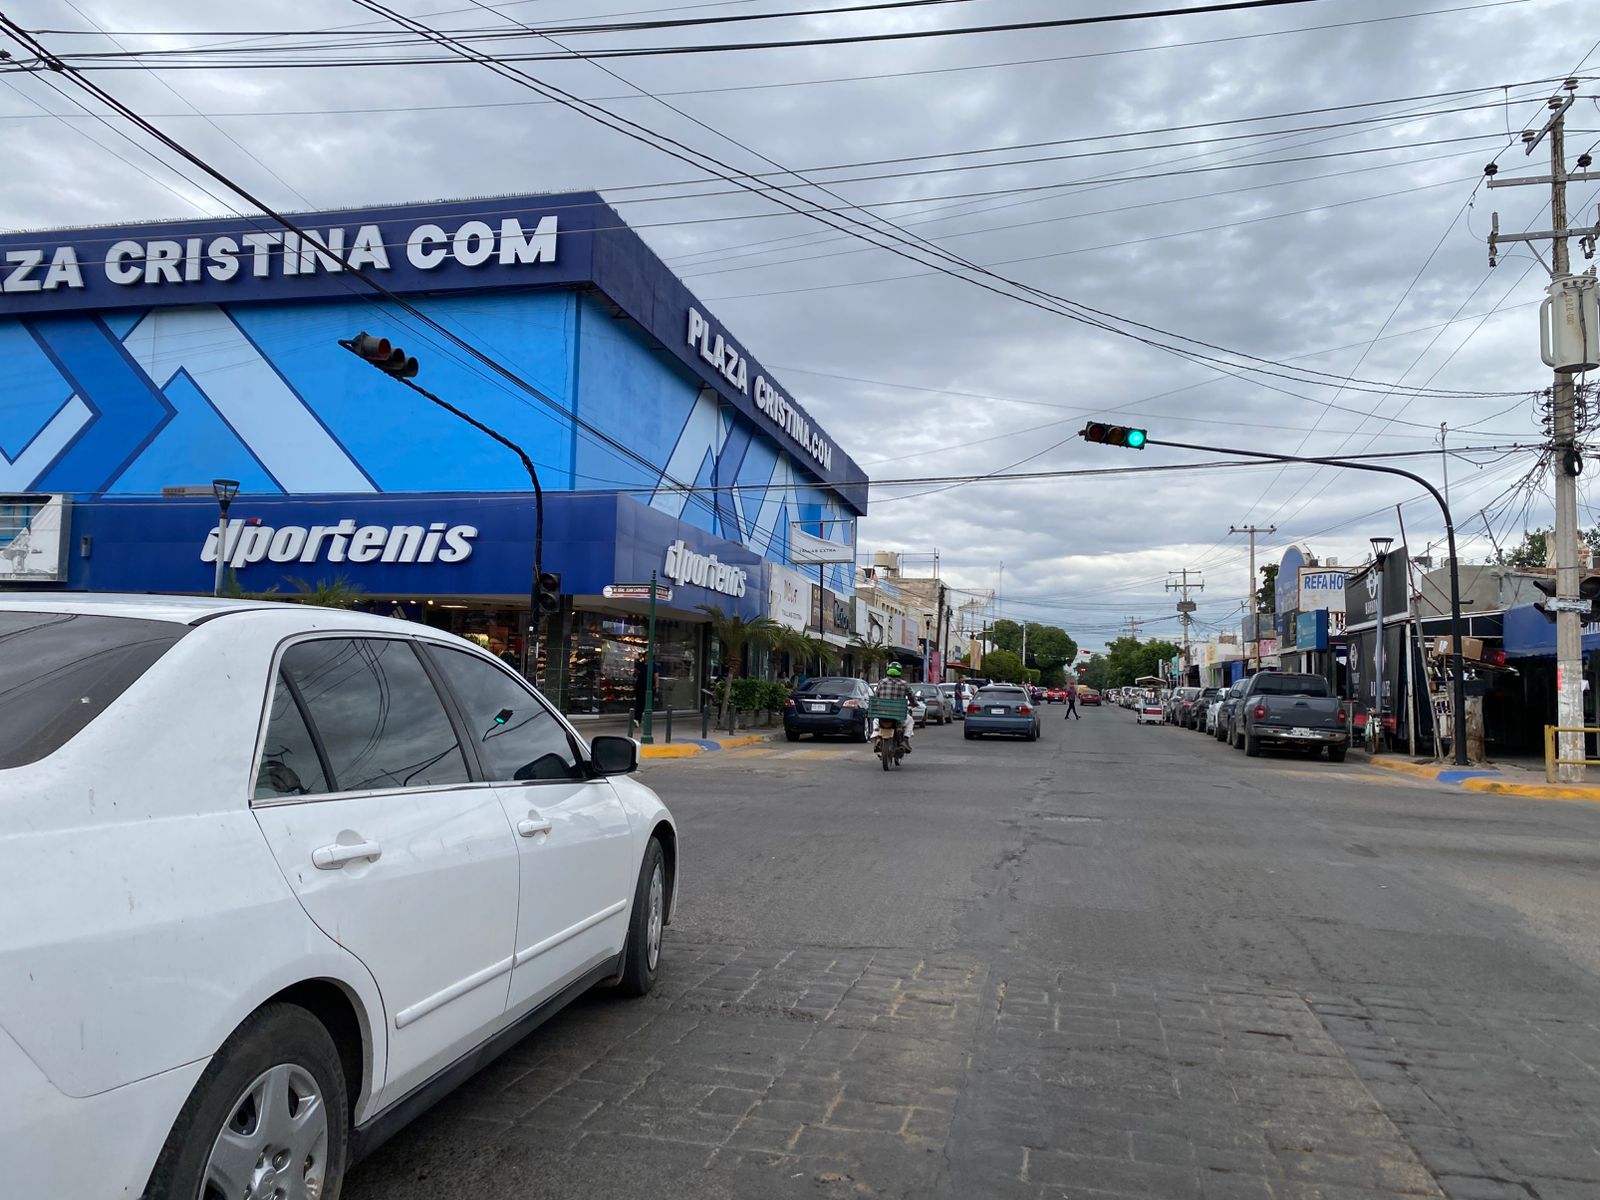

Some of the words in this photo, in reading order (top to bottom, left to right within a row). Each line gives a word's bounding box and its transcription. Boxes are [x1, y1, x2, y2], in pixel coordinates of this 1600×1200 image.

[0, 246, 84, 293] ZA
[104, 225, 391, 285] CRISTINA
[406, 214, 558, 270] COM
[687, 306, 748, 396] PLAZA
[1304, 575, 1328, 590] REFA
[1329, 573, 1351, 591] HO
